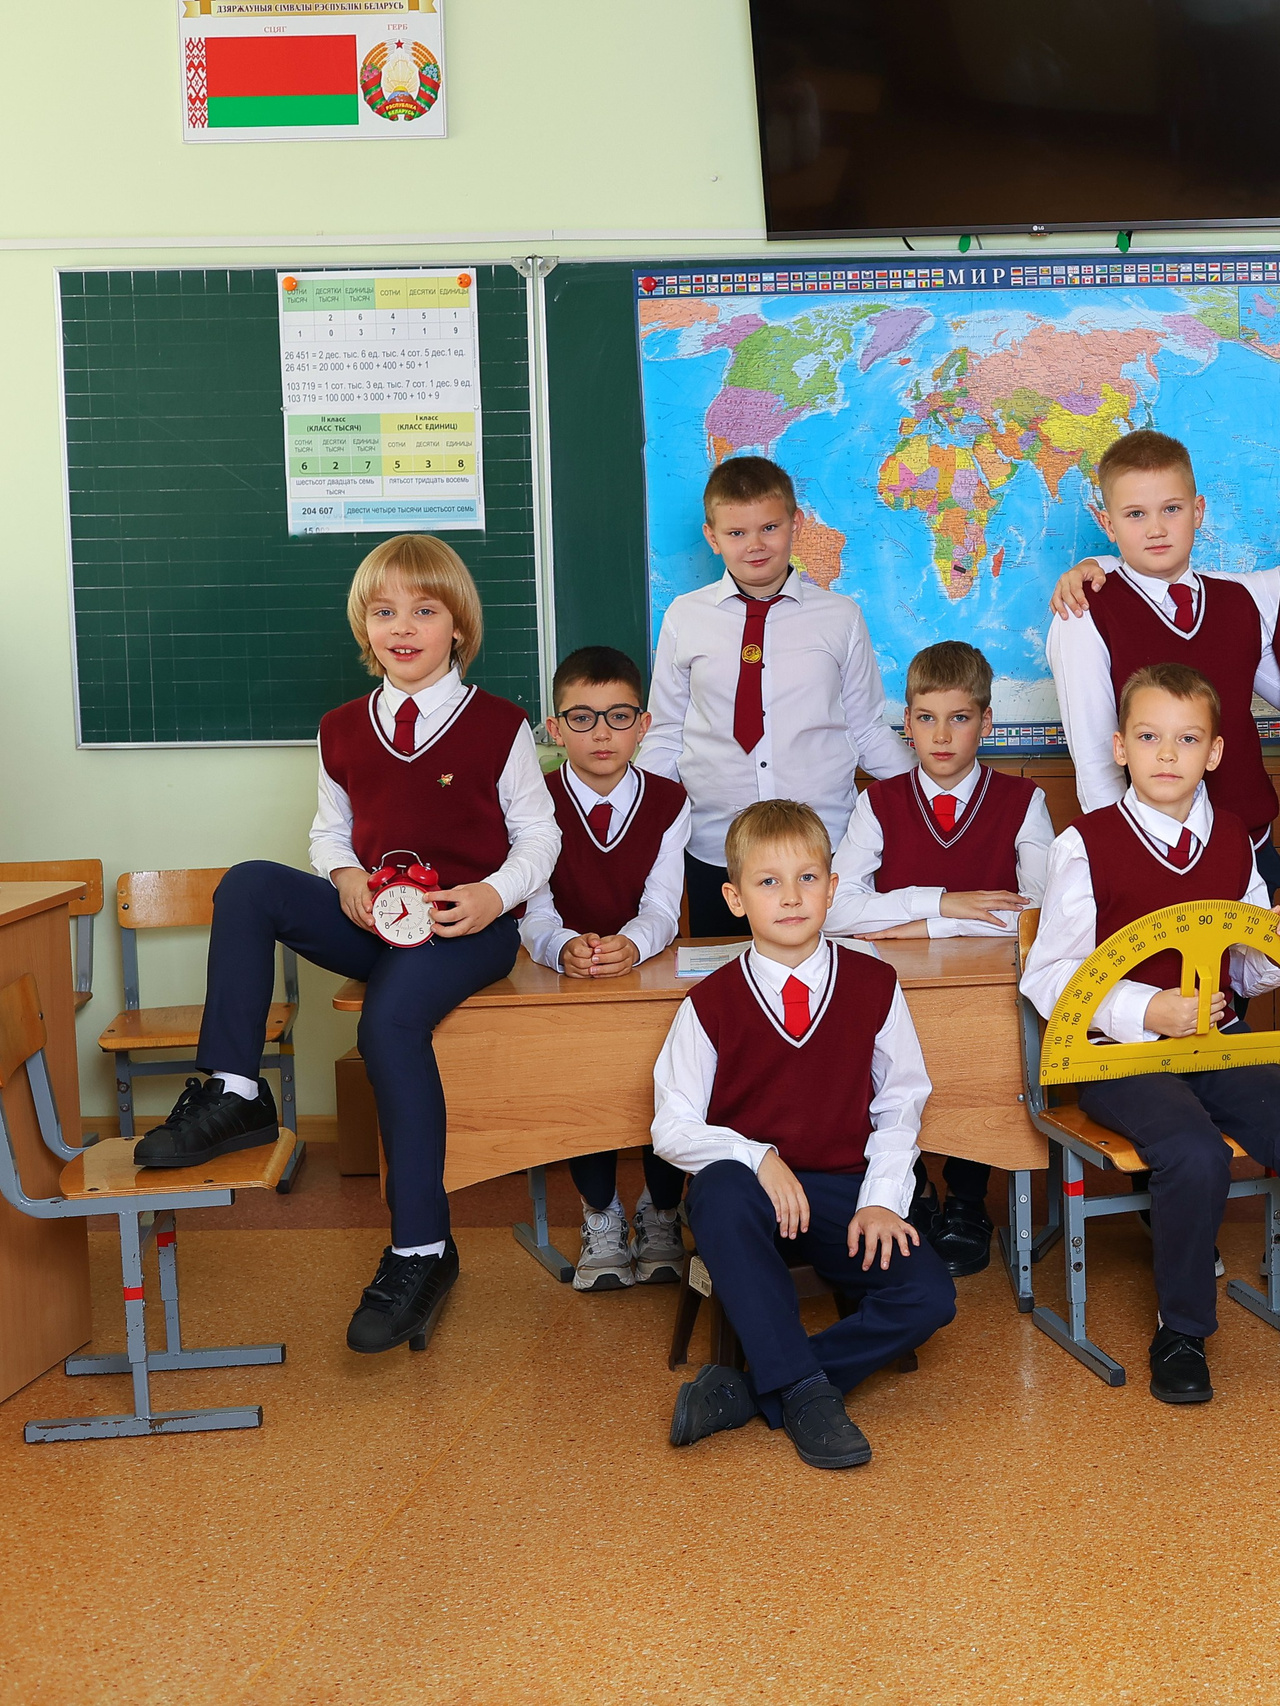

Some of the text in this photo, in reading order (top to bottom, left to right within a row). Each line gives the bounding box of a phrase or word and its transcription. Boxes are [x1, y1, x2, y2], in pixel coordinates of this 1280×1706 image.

[275, 3, 312, 12] СІМВАЛЫ
[314, 3, 362, 11] РЭСПУБЛІКІ
[364, 2, 404, 10] БЕЛАРУСЬ
[264, 26, 287, 34] СЦЯГ
[947, 268, 1006, 286] МИР
[318, 350, 323, 359] 2
[325, 352, 341, 360] дес.
[361, 350, 366, 358] 6
[400, 349, 405, 357] 4
[424, 349, 430, 357] 5
[335, 424, 361, 432] ТЫСЯЧ)
[301, 461, 371, 470] 6 2 7
[395, 460, 400, 468] 5
[426, 460, 431, 468] 3
[327, 478, 357, 486] двадцать
[1128, 933, 1139, 943] 60
[1152, 922, 1162, 930] 70
[1198, 915, 1213, 925] 90
[1223, 912, 1237, 920] 100
[1247, 916, 1260, 925] 110
[1132, 922, 1254, 953] 120 110 100 80 70
